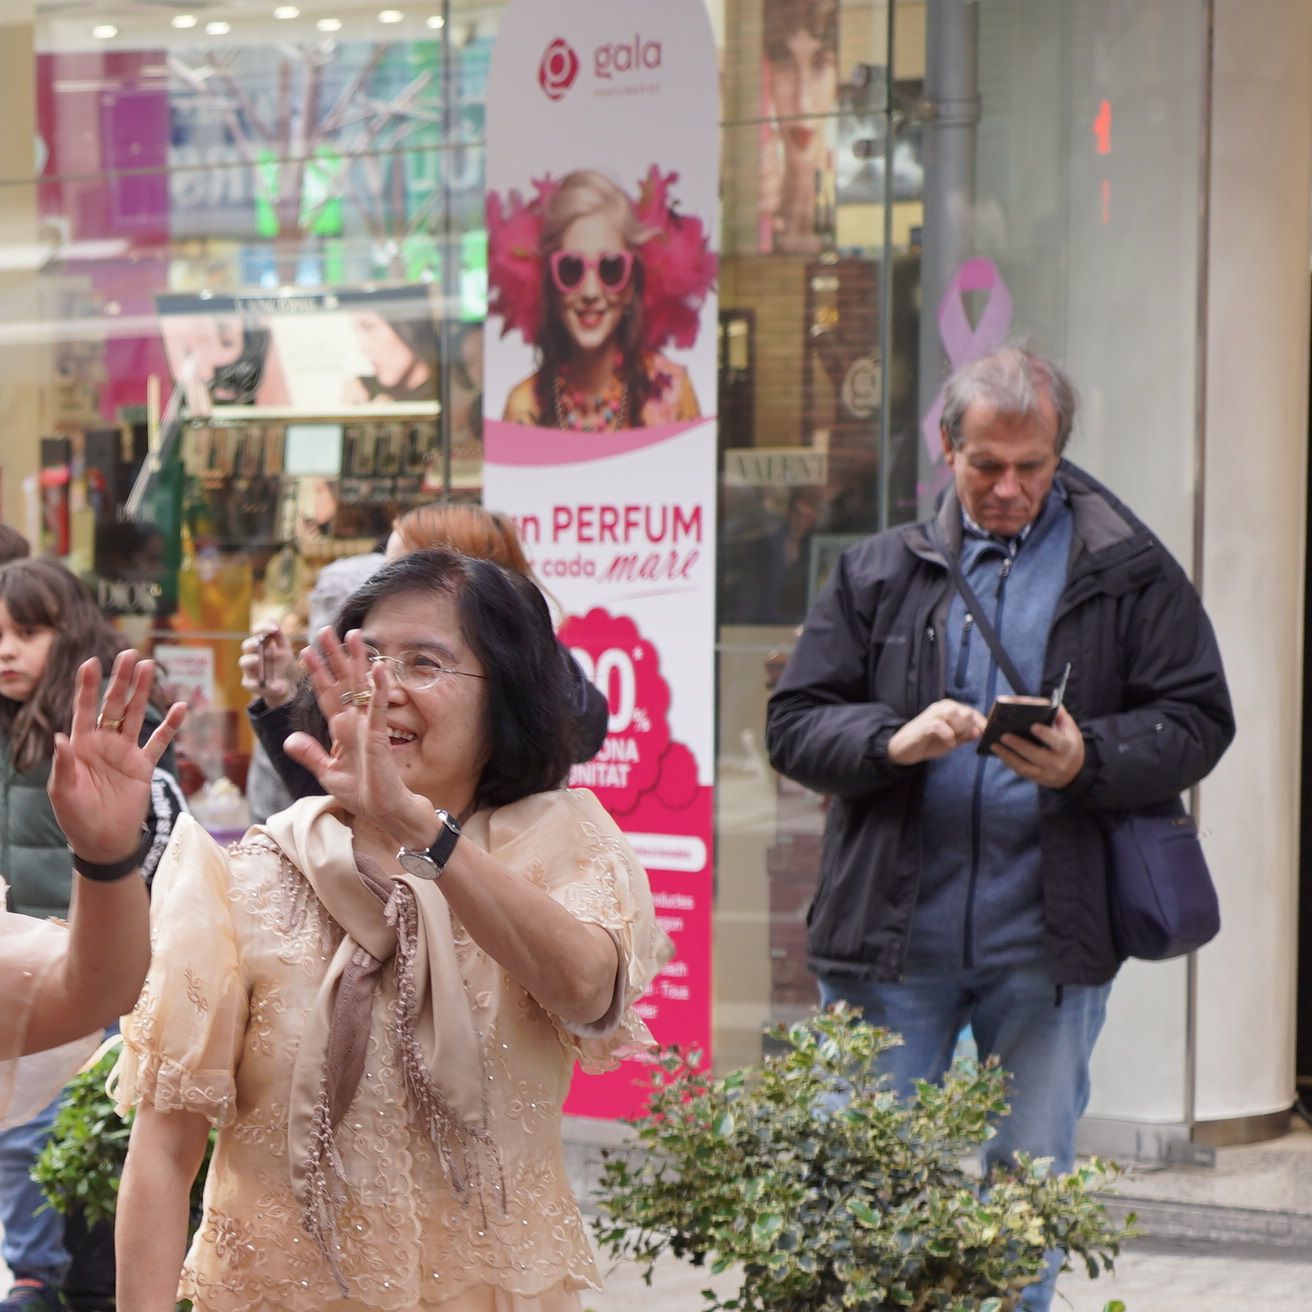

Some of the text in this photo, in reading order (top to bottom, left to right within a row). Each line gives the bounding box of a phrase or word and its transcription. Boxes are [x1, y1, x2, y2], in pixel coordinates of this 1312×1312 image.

[594, 33, 662, 79] gala
[552, 505, 702, 544] PERFUM
[542, 556, 596, 578] cada
[598, 550, 700, 584] mare
